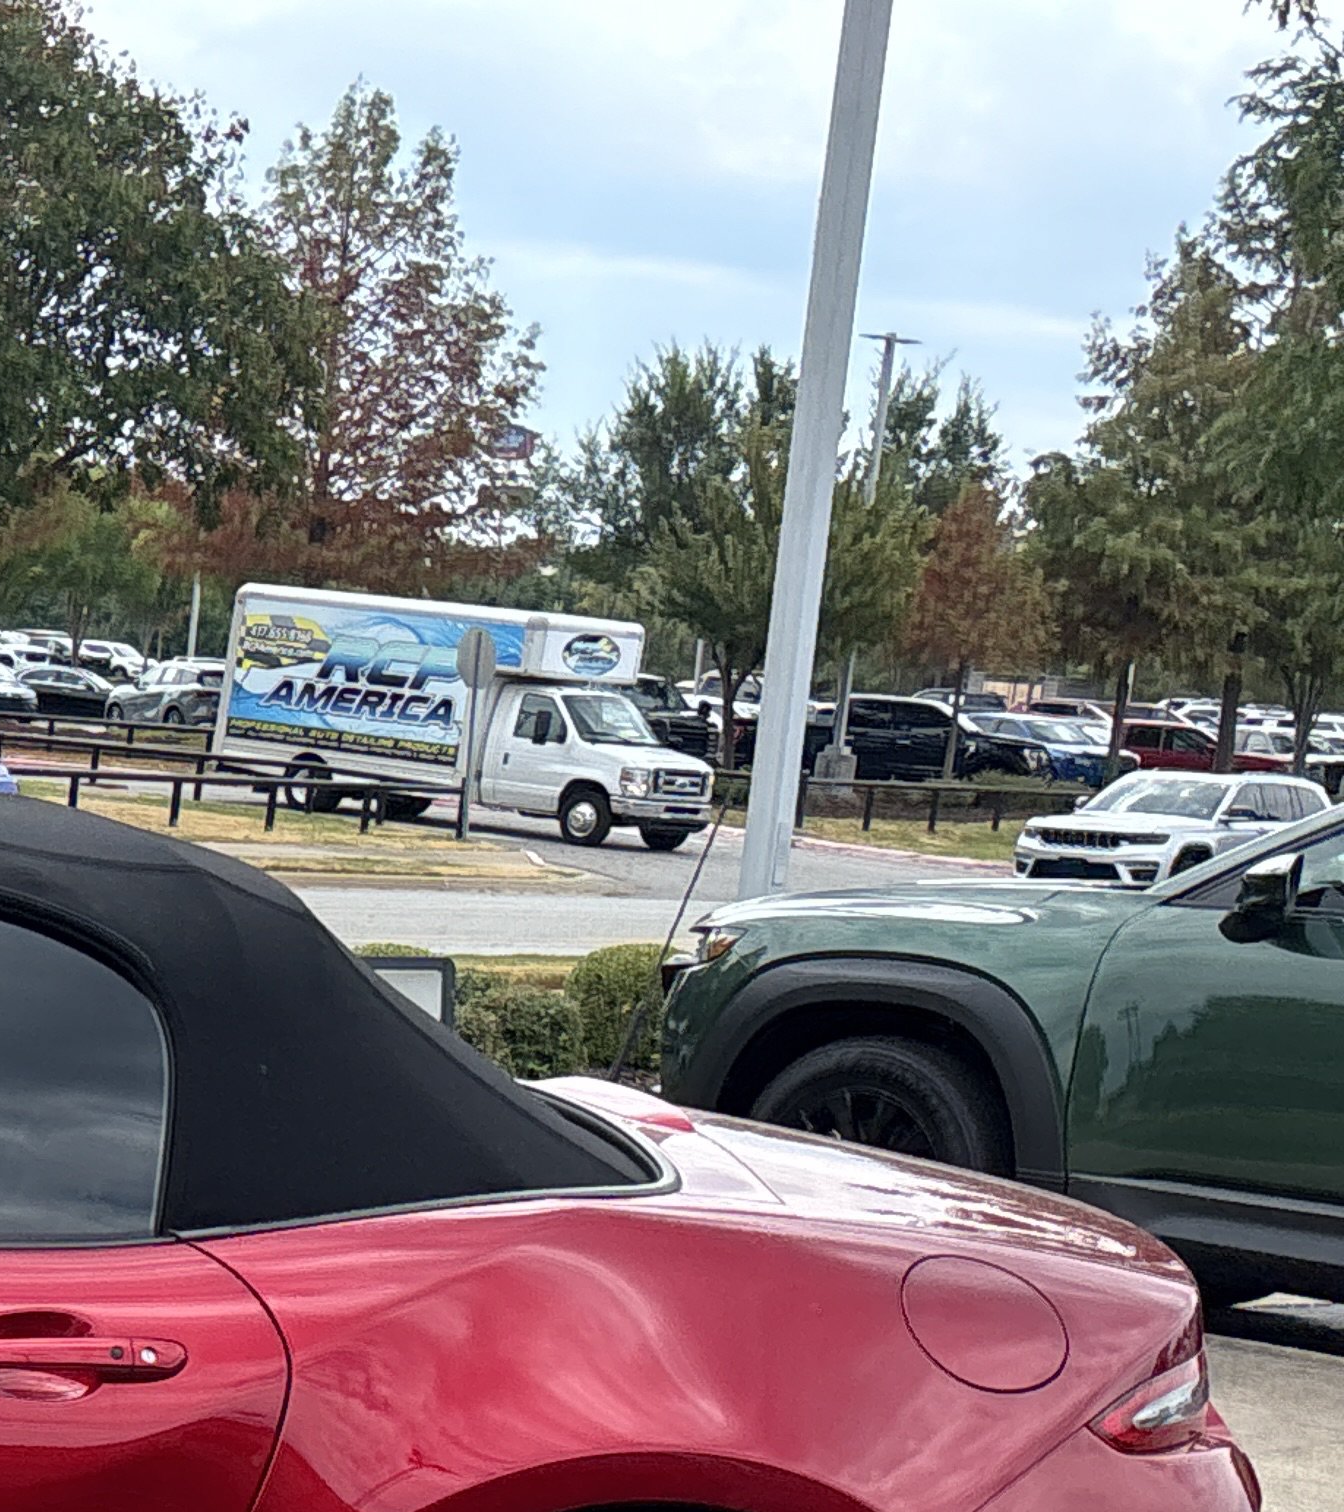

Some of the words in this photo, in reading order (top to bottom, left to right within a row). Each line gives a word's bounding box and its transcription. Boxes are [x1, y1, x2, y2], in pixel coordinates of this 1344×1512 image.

[315, 635, 462, 691] RCP
[262, 678, 454, 727] AMERICA
[308, 729, 339, 740] AUTO
[397, 740, 456, 756] PRODUCTS
